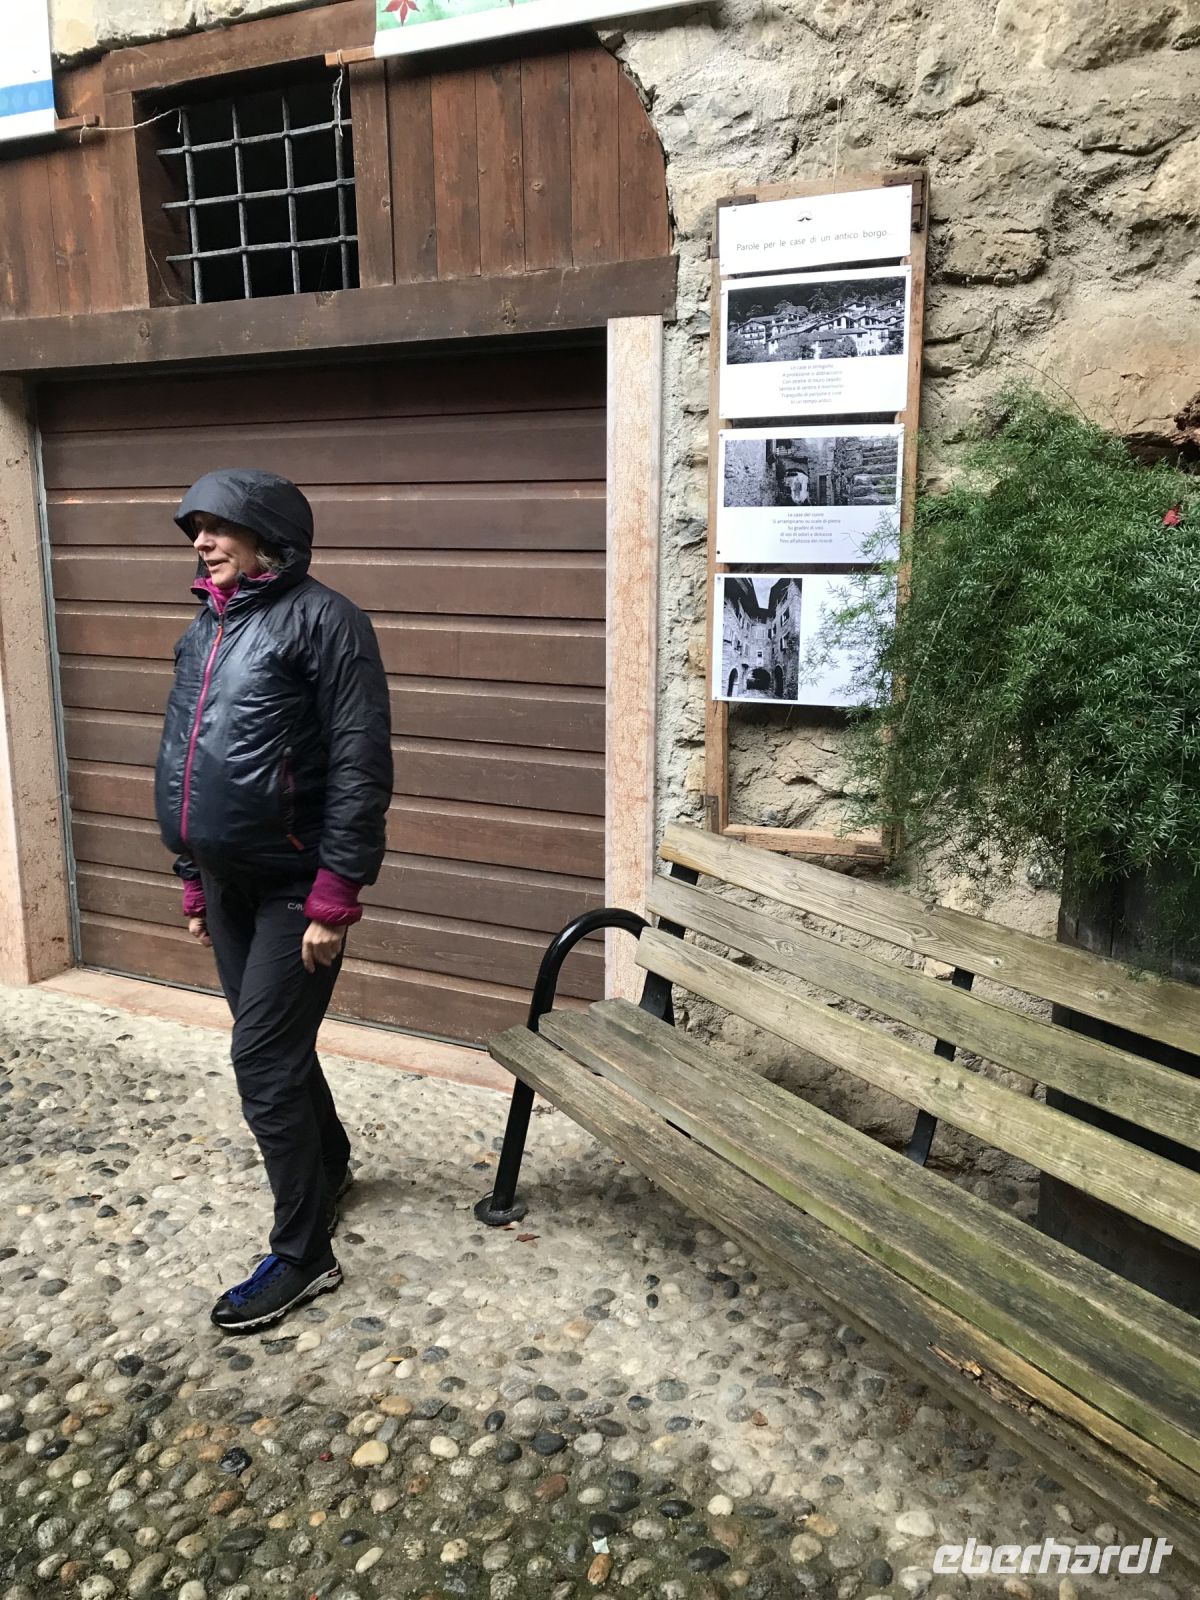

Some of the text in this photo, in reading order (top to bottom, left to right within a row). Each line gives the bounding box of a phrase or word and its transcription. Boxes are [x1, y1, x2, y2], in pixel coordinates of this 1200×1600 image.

[736, 243, 760, 251] Parole
[763, 241, 776, 251] per
[779, 239, 786, 247] le
[789, 238, 807, 246] case
[810, 235, 817, 244] di
[834, 232, 859, 241] antico
